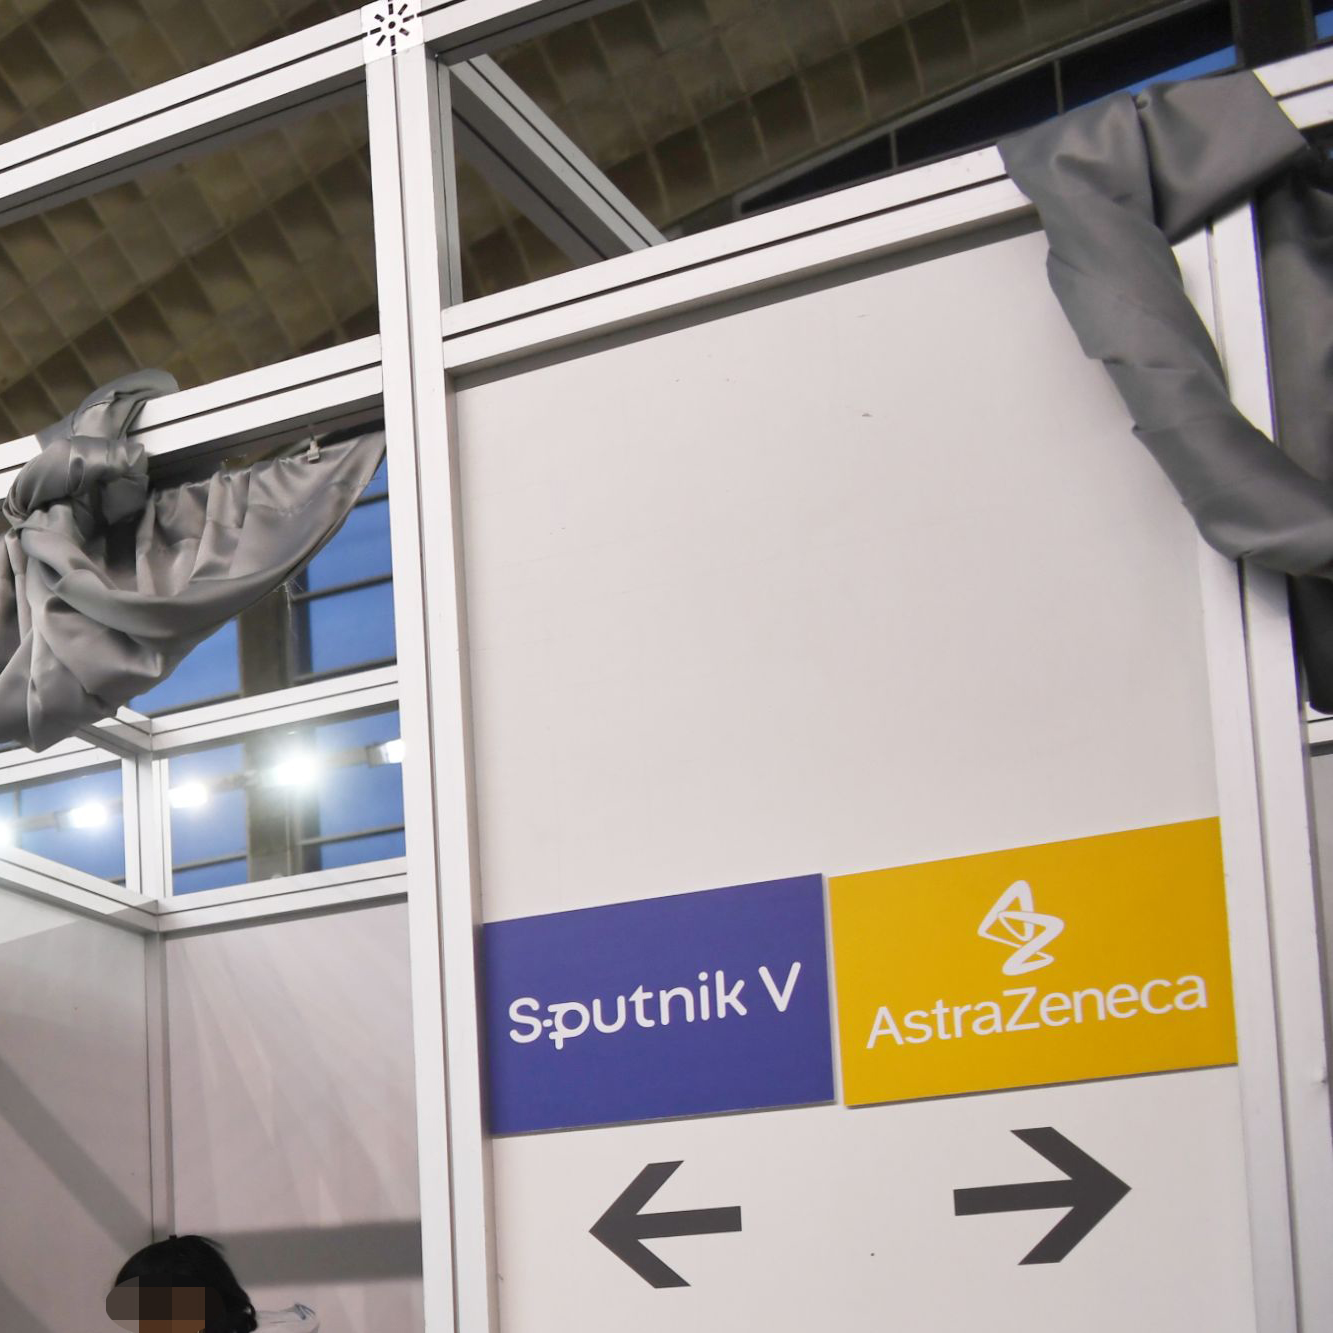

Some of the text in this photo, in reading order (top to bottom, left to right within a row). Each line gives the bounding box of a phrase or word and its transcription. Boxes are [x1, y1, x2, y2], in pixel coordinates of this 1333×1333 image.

[508, 961, 801, 1050] Sputnik V
[866, 973, 1209, 1049] AstraZeneca
